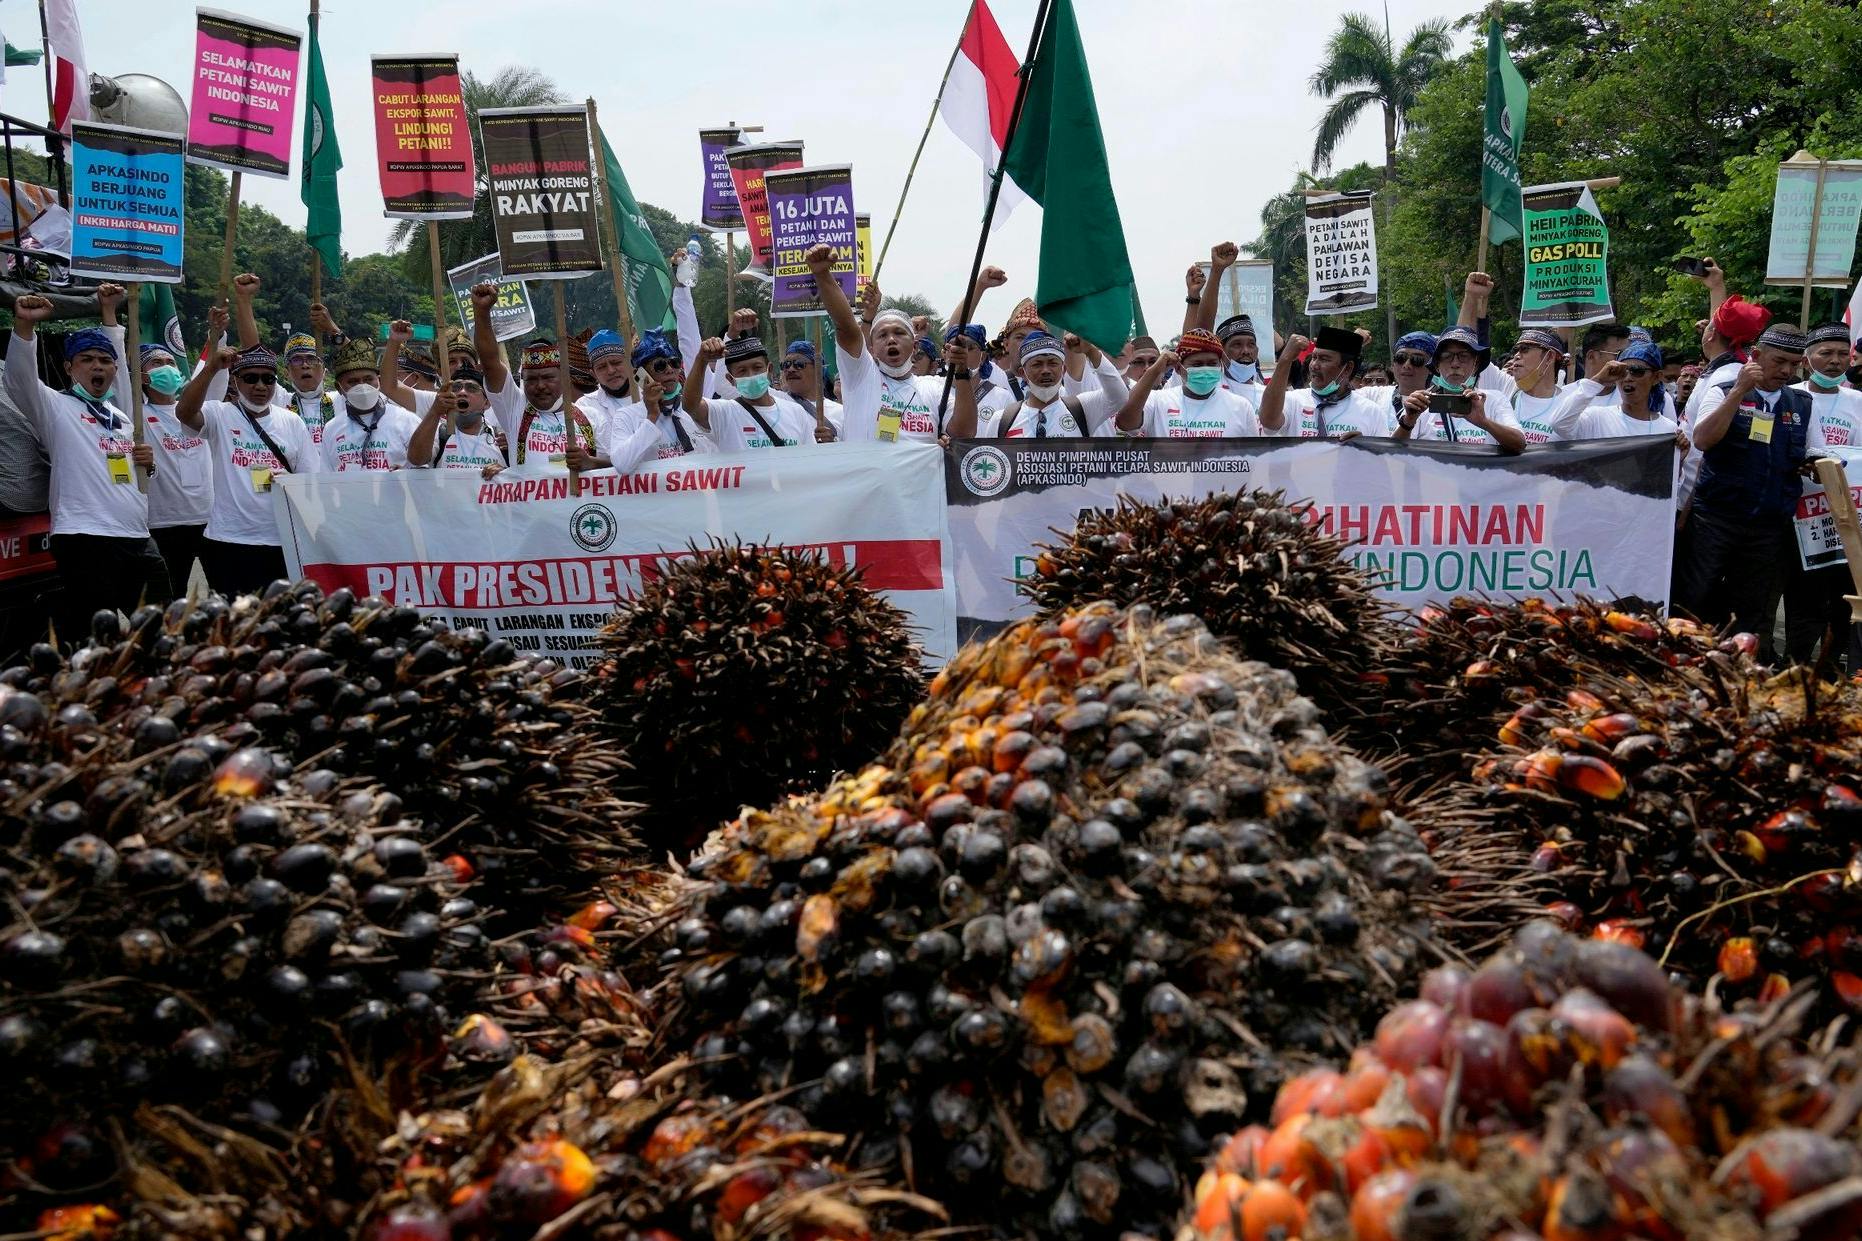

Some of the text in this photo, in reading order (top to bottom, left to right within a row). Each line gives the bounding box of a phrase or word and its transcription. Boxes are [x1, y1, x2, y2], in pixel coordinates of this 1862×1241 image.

[201, 51, 292, 81] SELAMATKAN
[199, 67, 292, 98] PETANI SAWIT
[207, 86, 280, 112] INDONESIA
[378, 94, 461, 104] CABUT LARANGAN
[386, 108, 458, 119] EKSPOR SAWIT,
[394, 123, 453, 135] LINDUNGI
[398, 137, 452, 150] PETANI!!
[88, 163, 170, 184] APKASINDO
[491, 160, 587, 175] BANGUN PABRIK
[91, 181, 166, 200] BERJUANG
[494, 176, 589, 191] MINYAK GORENG
[78, 196, 179, 218] UNTUK SEMUA
[497, 192, 590, 216] RAKYAT
[775, 195, 849, 220] 16 JUTA
[80, 215, 177, 235] (NKRI HARGA MATI)
[781, 218, 846, 234] PETANI DAN
[1309, 218, 1369, 234] PETANI SAWIT
[776, 231, 853, 248] PEKERJA SAWIT
[1313, 228, 1368, 243] ADALAH
[1529, 228, 1604, 243] MINYAK GORENG,
[1313, 239, 1369, 256] PAHLAWAN
[1530, 242, 1602, 263] GAS POLL
[1315, 252, 1371, 269] DEVISA
[1316, 265, 1371, 281] NEGARA
[1535, 263, 1597, 277] PRODUKSI
[1529, 275, 1603, 290] MINYAK CURAH
[496, 306, 527, 318] SAWIT
[900, 420, 934, 433] NESIA
[1168, 418, 1226, 429] SELAMATKAN
[1519, 420, 1554, 435] MATKAN
[1825, 426, 1850, 437] SAWIT
[1199, 429, 1224, 437] SAWIT
[1524, 431, 1550, 443] SAWIT
[1016, 450, 1150, 463] DEWAN PIMPINAN PUSAT
[1016, 461, 1249, 474] ASOSIASI PETANI KELAPA SAWIT INDONESIA
[478, 466, 746, 505] HARAPAN PETANI SAWIT
[1017, 474, 1088, 487] (APKASINDO)
[1804, 494, 1831, 515] PA
[1290, 503, 1545, 546] RIHATINAN
[1811, 532, 1820, 541] 2.
[0, 537, 21, 560] VE
[1353, 549, 1598, 592] INDONESIA
[366, 564, 450, 607] PAK
[454, 557, 645, 608] PRESIDEN
[453, 616, 490, 632] CABUT
[494, 613, 565, 631] LARANGAN
